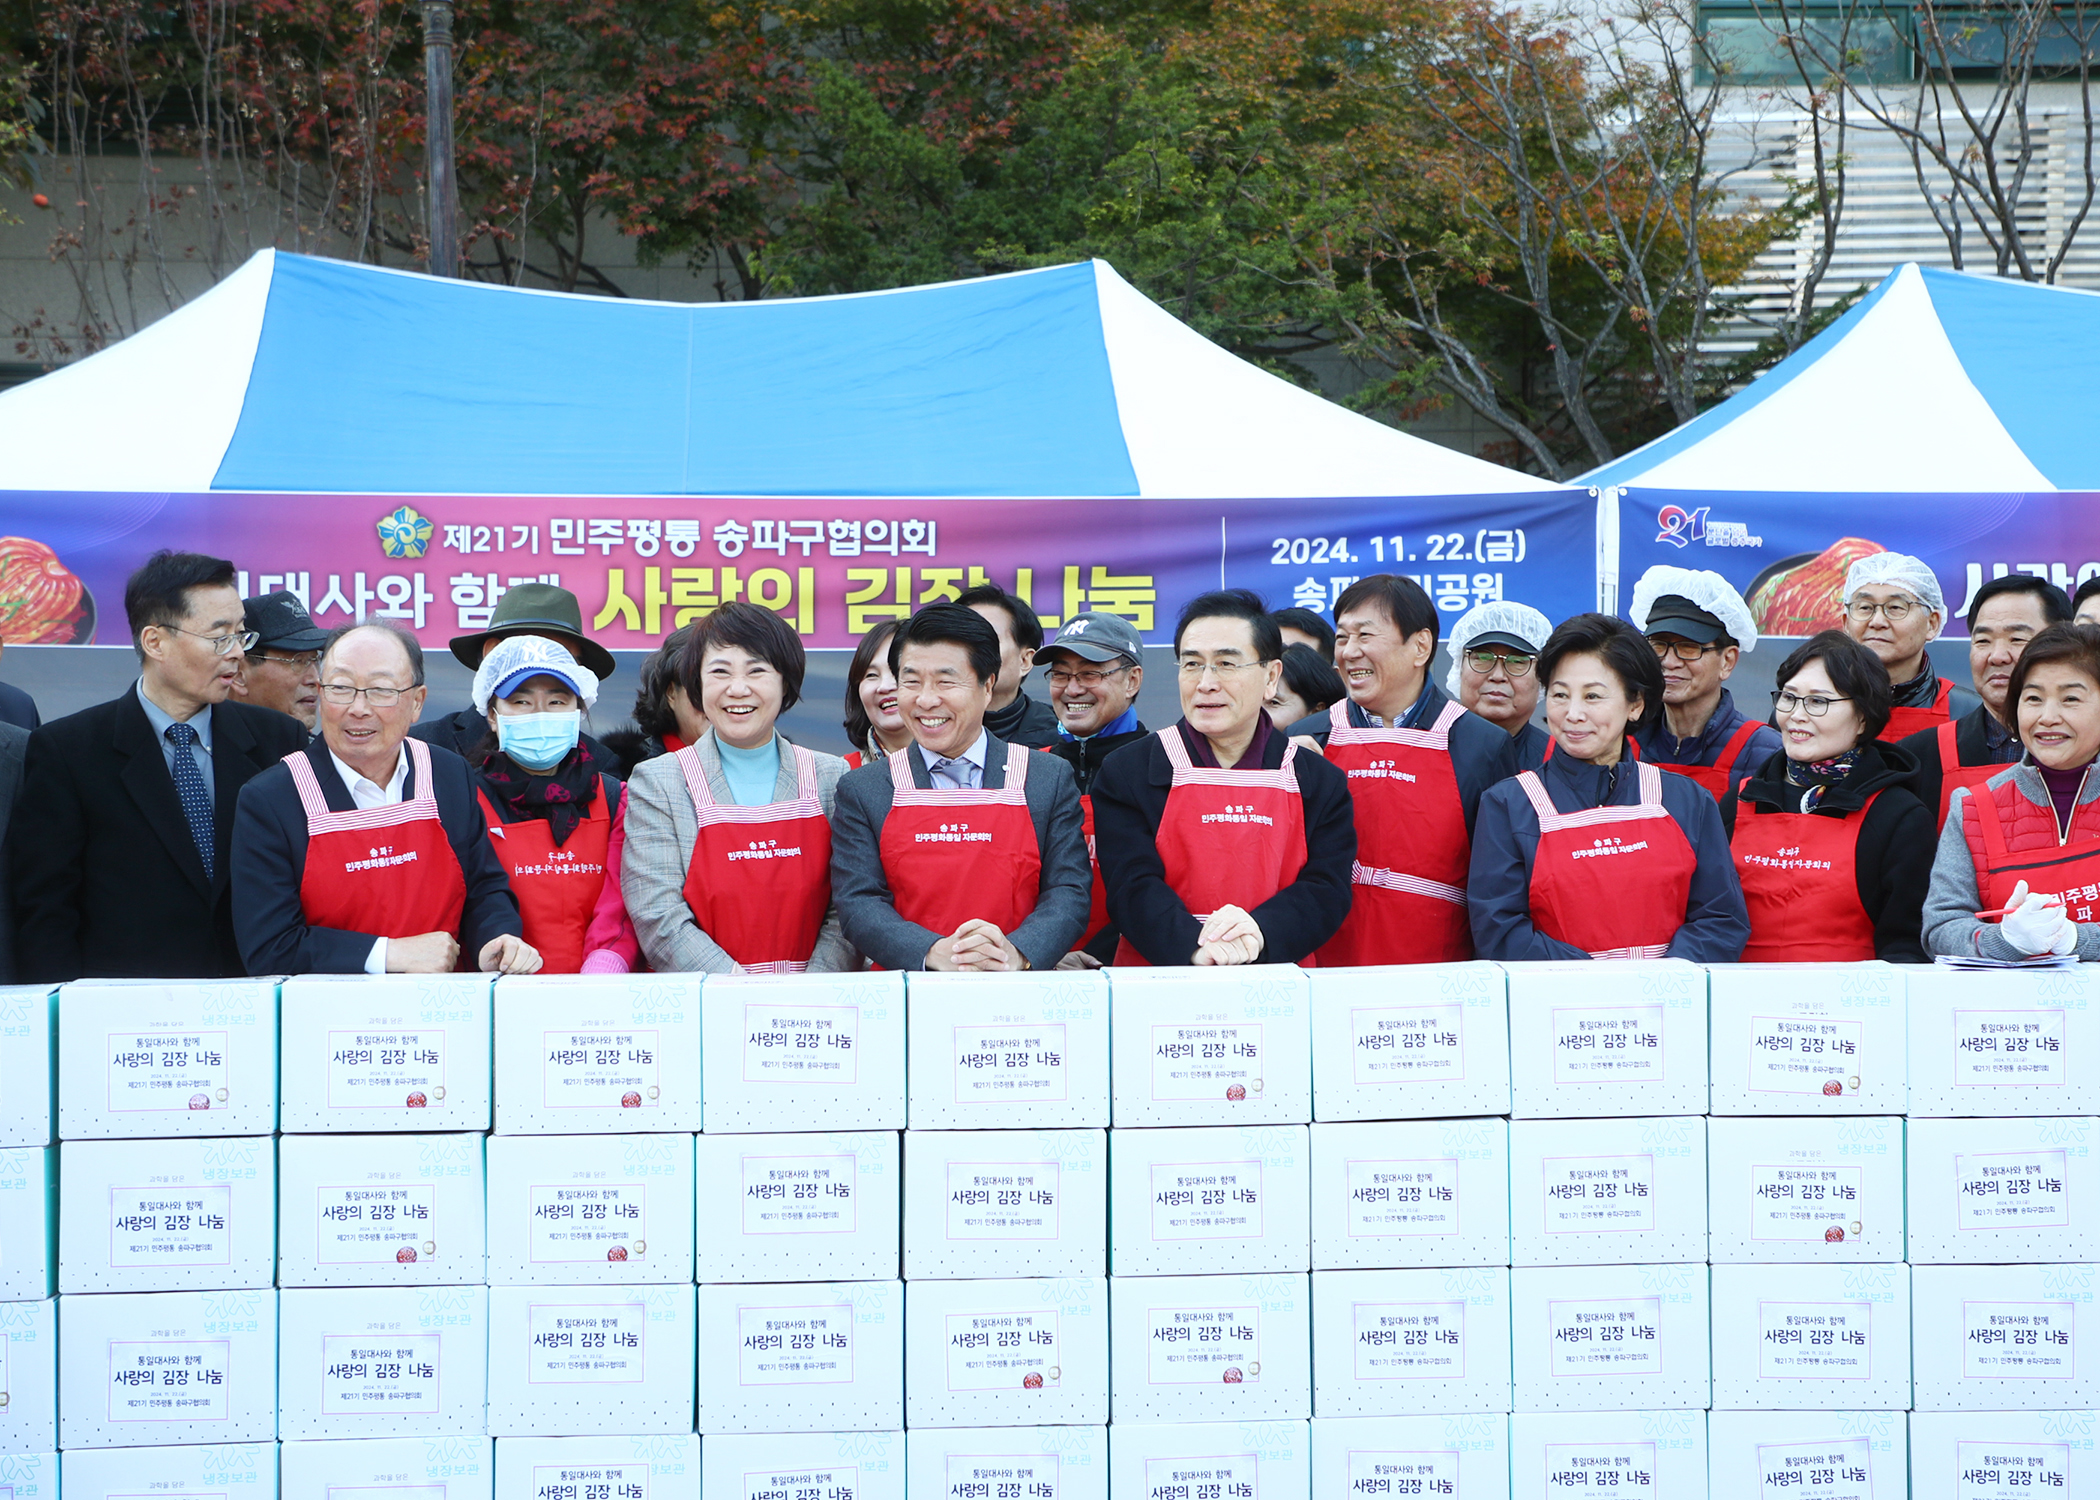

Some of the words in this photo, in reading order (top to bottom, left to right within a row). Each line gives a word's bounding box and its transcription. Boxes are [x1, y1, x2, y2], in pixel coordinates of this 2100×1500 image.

[443, 524, 538, 554] 제21기
[550, 518, 701, 557] 민주평통
[712, 519, 937, 557] 송파구협의회
[1270, 537, 1359, 565] 2024.
[1369, 535, 1416, 562] 11.
[1426, 529, 1526, 563] 22.(금)
[1016, 565, 1157, 631] 나눔
[1378, 1020, 1417, 1030] 통일대사와
[1421, 1019, 1436, 1028] 함께
[1981, 1024, 2019, 1033] 통일대사와
[2024, 1024, 2039, 1033] 함께
[137, 1038, 178, 1048] 통일대사와
[183, 1037, 200, 1047] 함께
[571, 1036, 611, 1046] 통일대사와
[616, 1036, 632, 1045] 함께
[749, 1032, 787, 1047] 사랑의
[795, 1033, 820, 1048] 김장
[828, 1034, 852, 1049] 나눔
[981, 1039, 1020, 1049] 통일대사와
[1025, 1039, 1040, 1048] 함께
[1358, 1034, 1394, 1050] 사랑의
[1402, 1033, 1426, 1048] 김장
[1434, 1032, 1457, 1046] 나눔
[1559, 1035, 1595, 1050] 사랑의
[1603, 1034, 1627, 1048] 김장
[1634, 1033, 1658, 1047] 나눔
[1756, 1036, 1792, 1051] 사랑의
[1800, 1038, 1825, 1053] 김장
[1832, 1040, 1856, 1054] 나눔
[1960, 1037, 1997, 1052] 사랑의
[2005, 1038, 2029, 1051] 김장
[2036, 1037, 2060, 1051] 나눔
[333, 1050, 372, 1065] 사랑의
[381, 1050, 406, 1065] 김장
[414, 1049, 439, 1064] 나눔
[549, 1050, 587, 1065] 사랑의
[596, 1050, 621, 1065] 김장
[629, 1049, 653, 1064] 나눔
[1157, 1044, 1193, 1058] 사랑의
[1202, 1043, 1226, 1058] 김장
[1234, 1043, 1257, 1057] 나눔
[113, 1052, 153, 1068] 사랑의
[162, 1052, 188, 1067] 김장
[196, 1051, 222, 1066] 나눔
[960, 1053, 997, 1068] 사랑의
[1005, 1052, 1029, 1067] 김장
[1037, 1052, 1061, 1066] 나눔
[974, 1177, 1013, 1186] 통일대사와
[1018, 1177, 1033, 1186] 함께
[952, 1190, 989, 1205] 사랑의
[997, 1190, 1022, 1205] 김장
[1030, 1190, 1054, 1205] 나눔
[1353, 1188, 1389, 1202] 사랑의
[1397, 1187, 1422, 1202] 김장
[1429, 1186, 1453, 1201] 나눔
[1757, 1184, 1793, 1199] 사랑의
[1801, 1185, 1826, 1199] 김장
[1833, 1185, 1856, 1200] 나눔
[535, 1205, 573, 1220] 사랑의
[582, 1204, 607, 1219] 김장
[615, 1204, 639, 1218] 나눔
[116, 1216, 156, 1231] 사랑의
[164, 1215, 191, 1230] 김장
[199, 1214, 225, 1229] 나눔
[1576, 1313, 1615, 1323] 통일대사와
[1619, 1312, 1635, 1321] 함께
[744, 1335, 782, 1350] 사랑의
[790, 1334, 815, 1349] 김장
[823, 1333, 848, 1348] 나눔
[1153, 1327, 1190, 1342] 사랑의
[1198, 1326, 1223, 1341] 김장
[1230, 1326, 1254, 1340] 나눔
[1555, 1327, 1592, 1342] 사랑의
[1600, 1326, 1624, 1341] 김장
[1632, 1325, 1656, 1339] 나눔
[1969, 1329, 2005, 1344] 사랑의
[2013, 1330, 2038, 1344] 김장
[2045, 1330, 2069, 1344] 나눔
[328, 1364, 367, 1379] 사랑의
[375, 1363, 401, 1378] 김장
[409, 1363, 434, 1378] 나눔
[1572, 1457, 1610, 1467] 통일대사와
[1615, 1457, 1630, 1466] 함께
[1551, 1471, 1587, 1486] 사랑의
[1595, 1471, 1620, 1486] 김장
[1627, 1470, 1651, 1485] 나눔
[538, 1485, 576, 1500] 사랑의
[585, 1484, 611, 1500] 김장
[618, 1484, 643, 1498] 나눔
